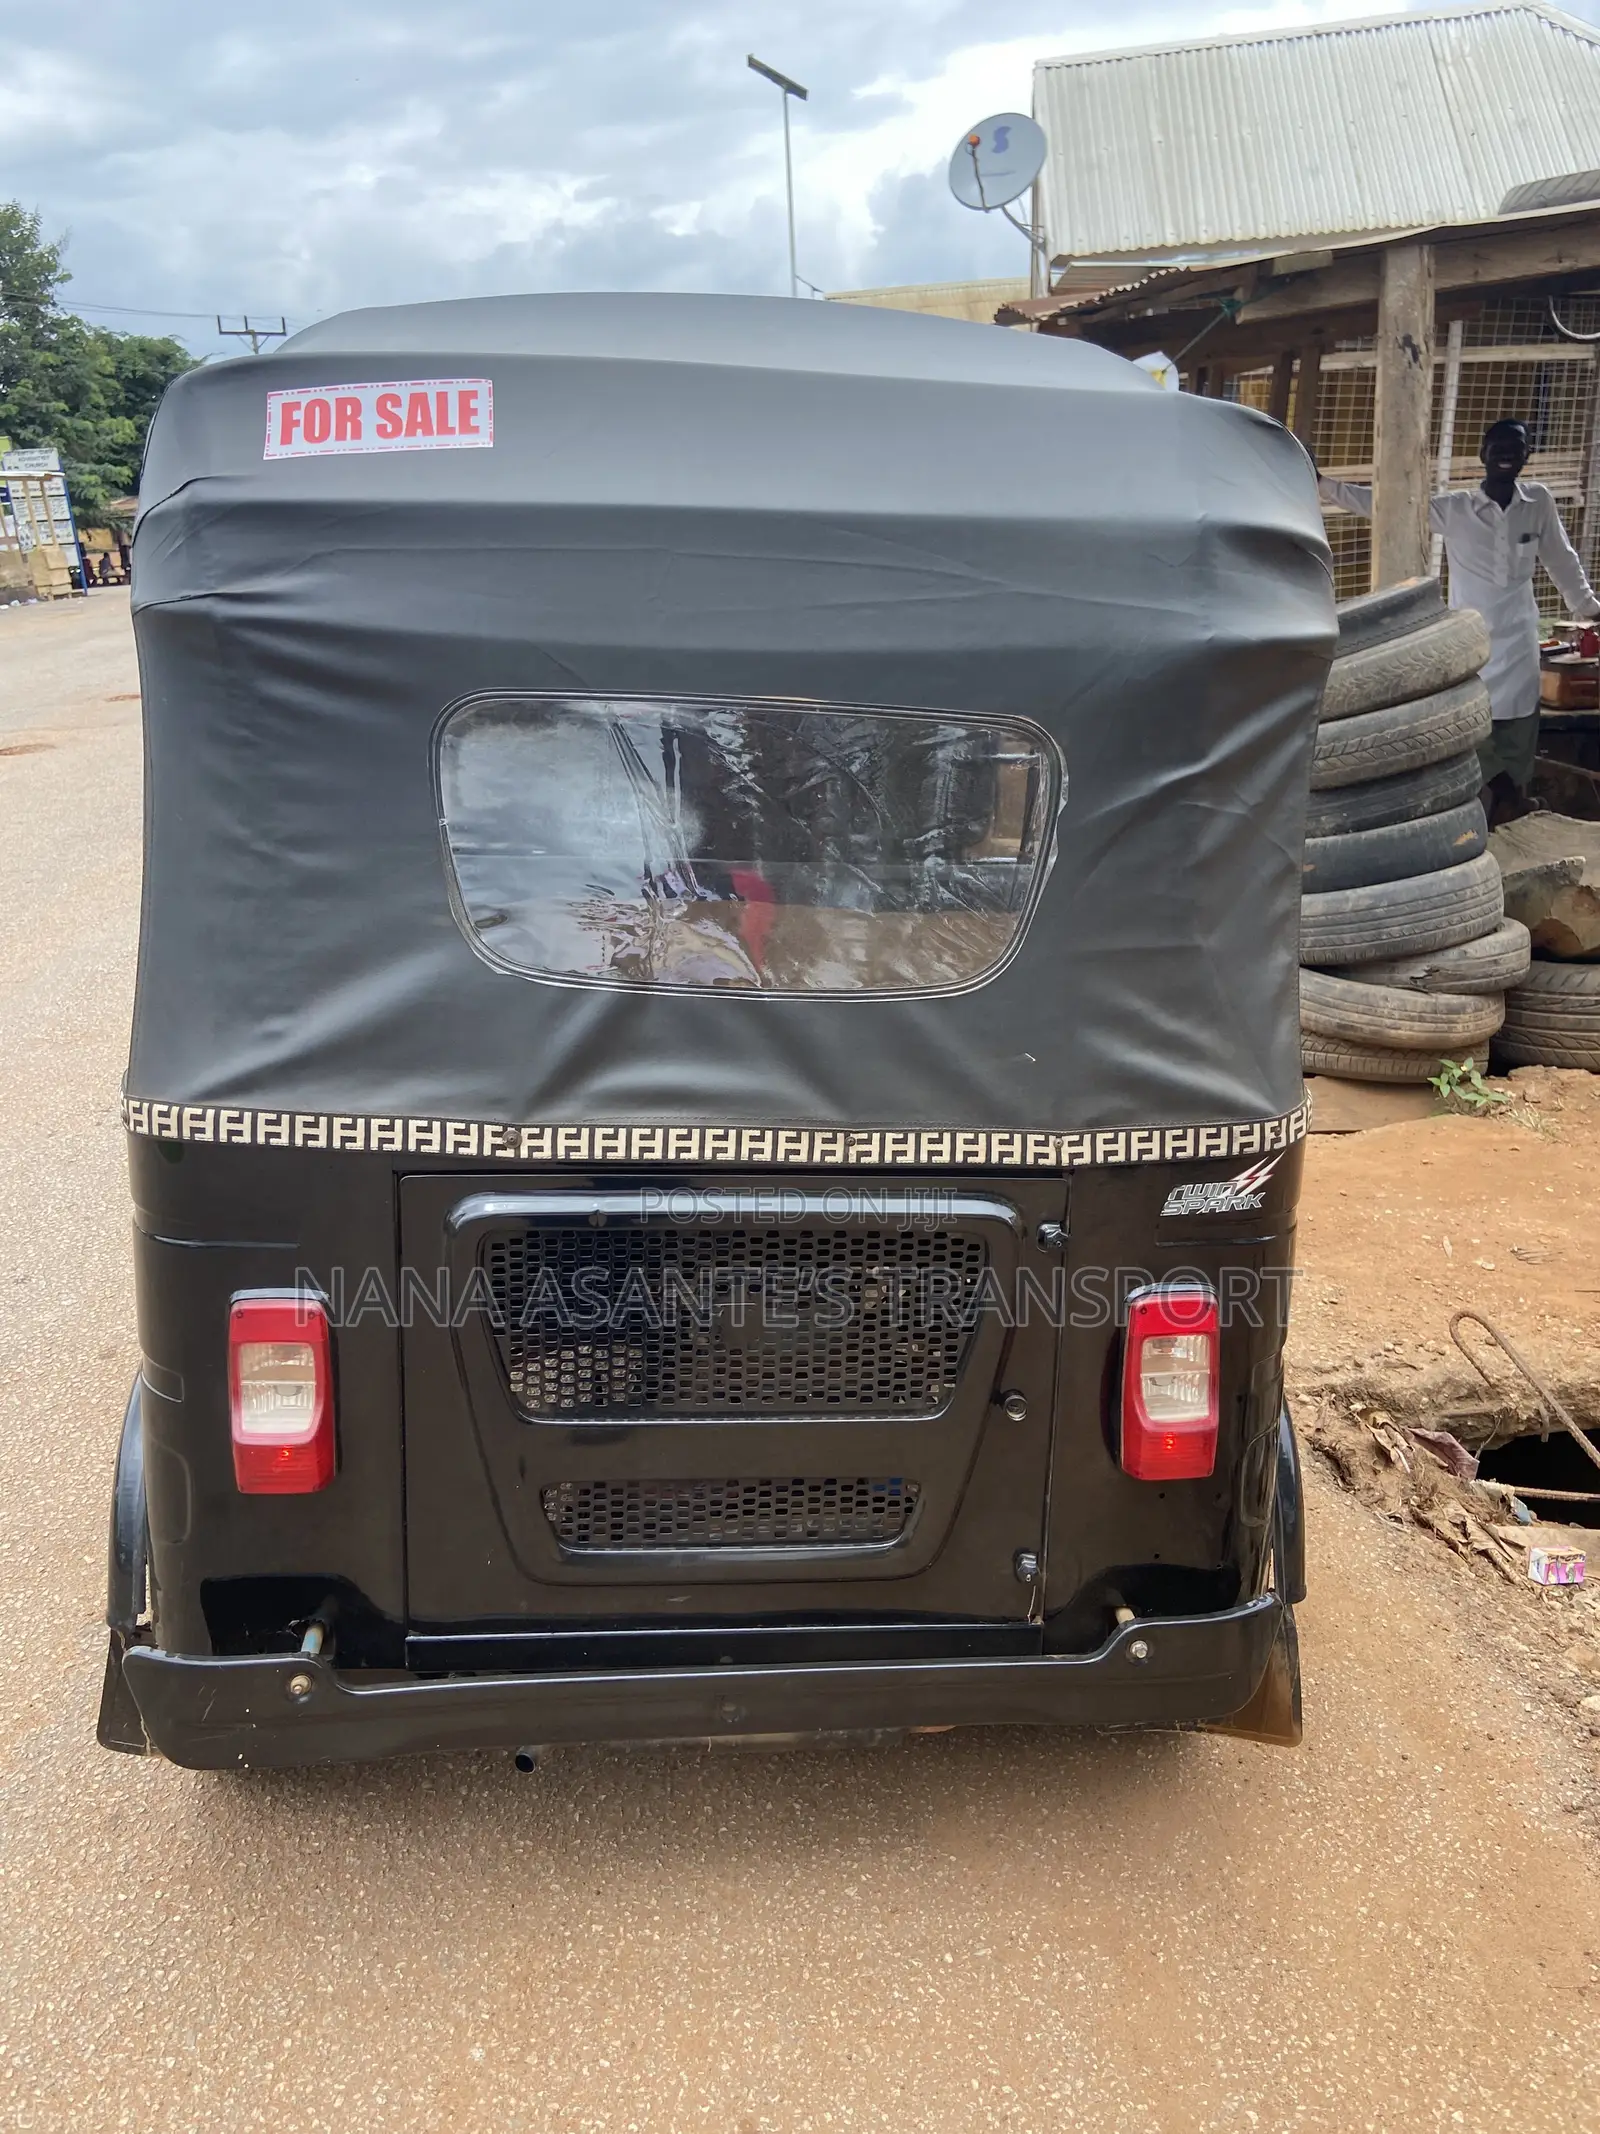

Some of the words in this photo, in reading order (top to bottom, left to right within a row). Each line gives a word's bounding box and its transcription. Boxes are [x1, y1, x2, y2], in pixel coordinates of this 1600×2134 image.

[279, 396, 363, 446] FOR
[375, 390, 480, 440] SALE
[1159, 1191, 1267, 1217] SPARK
